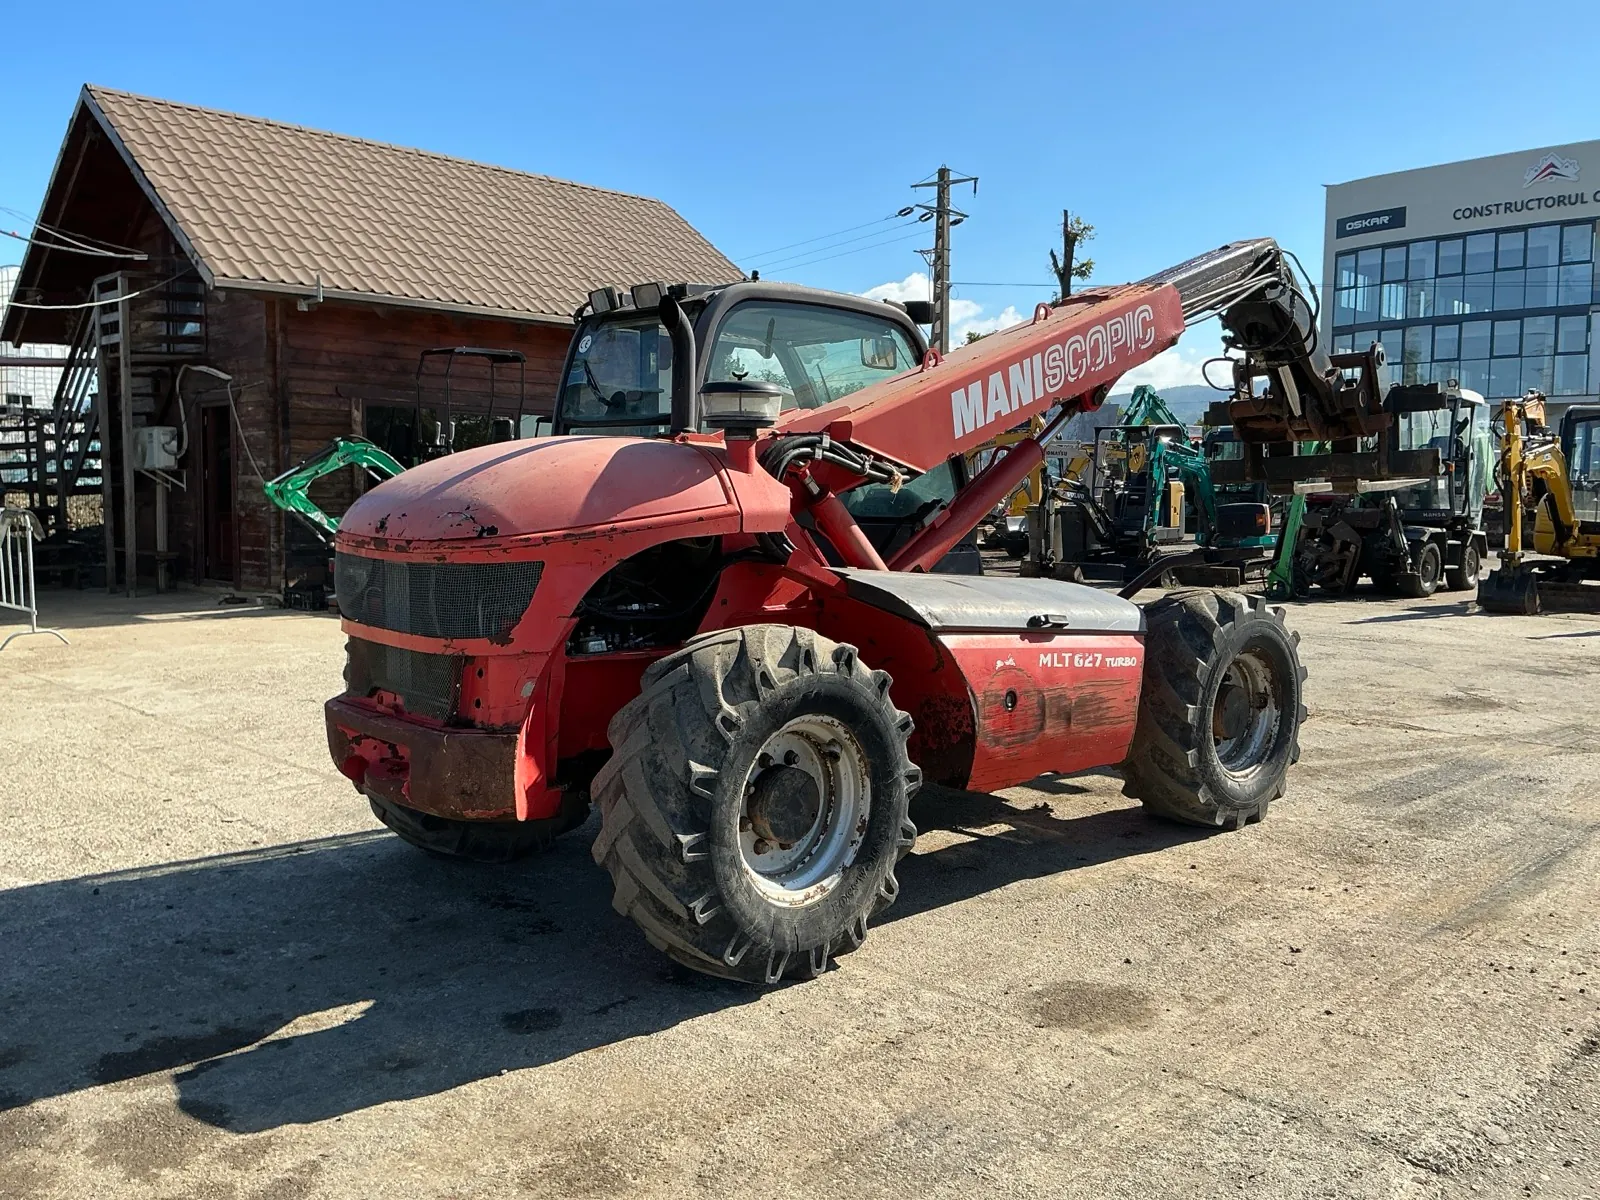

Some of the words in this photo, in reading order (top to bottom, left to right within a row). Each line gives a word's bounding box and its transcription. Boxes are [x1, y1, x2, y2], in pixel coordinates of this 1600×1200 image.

[1453, 192, 1588, 220] CONSTRUCTORUL
[1345, 216, 1389, 231] OSKAR
[951, 304, 1155, 439] MANISCOPIC
[1105, 656, 1137, 667] TURBO
